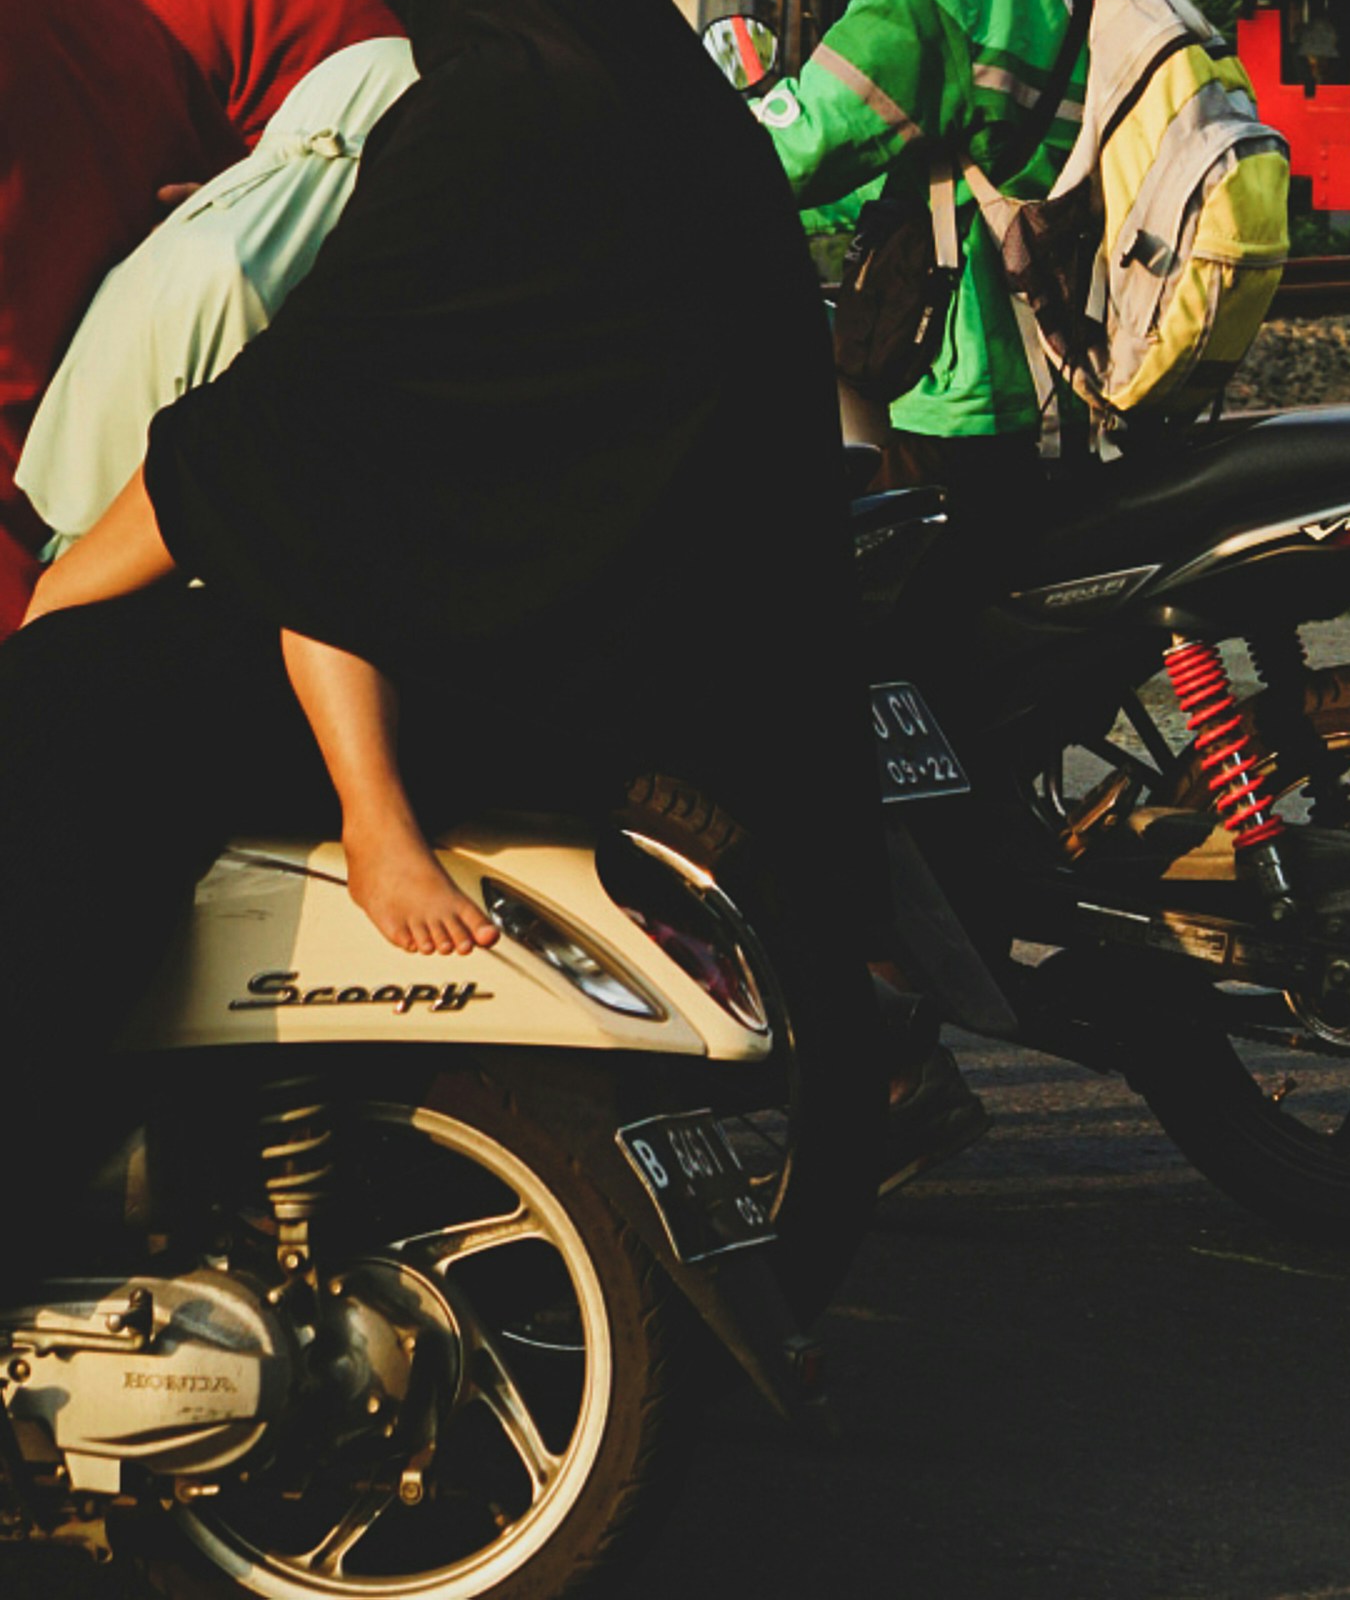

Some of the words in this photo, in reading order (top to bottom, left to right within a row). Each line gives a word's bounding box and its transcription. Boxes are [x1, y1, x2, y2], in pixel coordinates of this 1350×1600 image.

[228, 971, 494, 1014] Scoopy
[632, 1139, 669, 1189] B
[123, 1371, 239, 1393] HONDA
